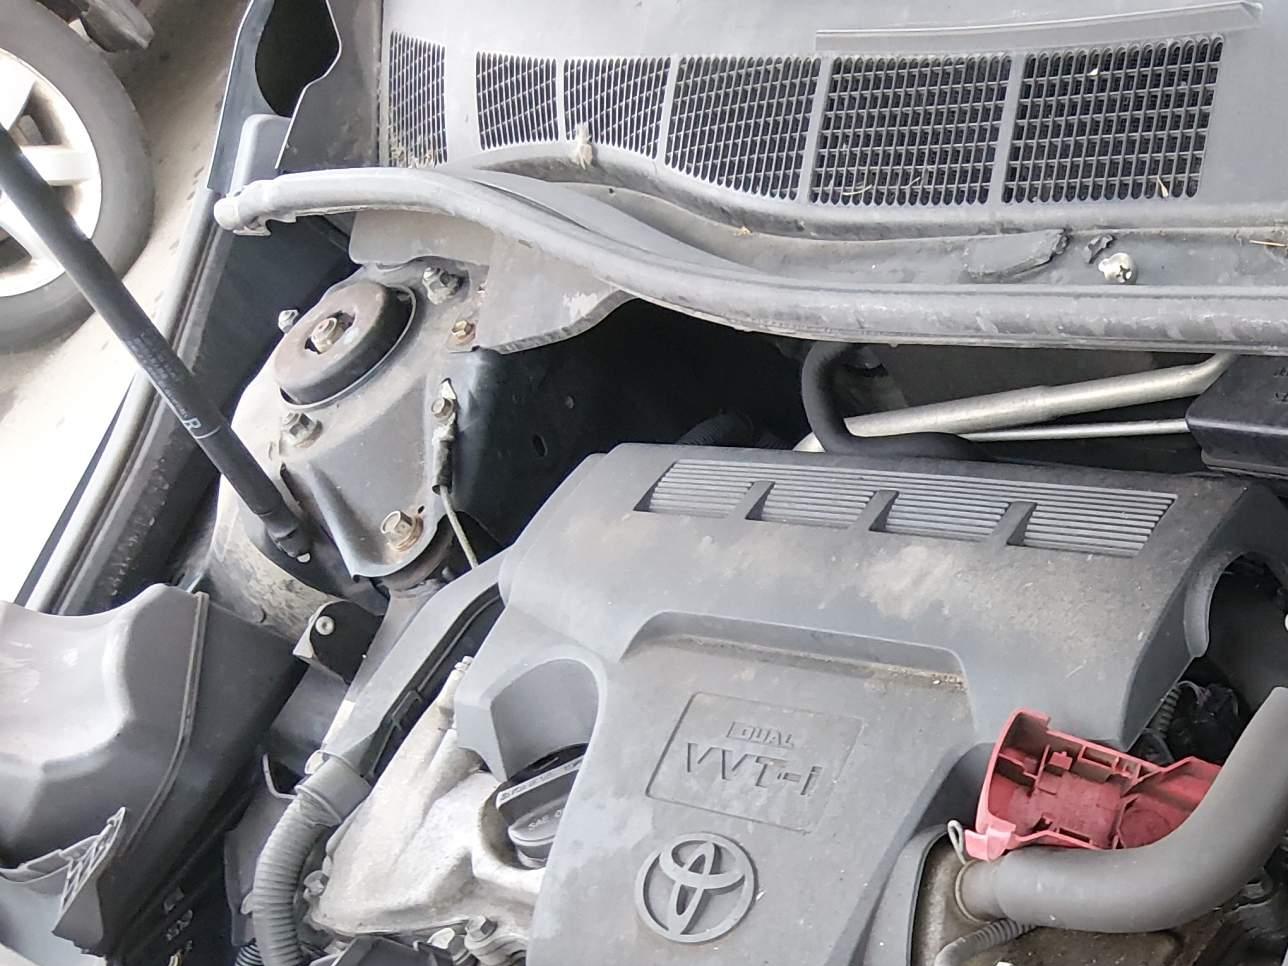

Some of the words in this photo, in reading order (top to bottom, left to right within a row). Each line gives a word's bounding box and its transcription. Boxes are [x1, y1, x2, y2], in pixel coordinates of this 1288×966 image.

[184, 417, 202, 434] R
[725, 720, 796, 749] DUAL
[686, 741, 824, 797] VVT-i
